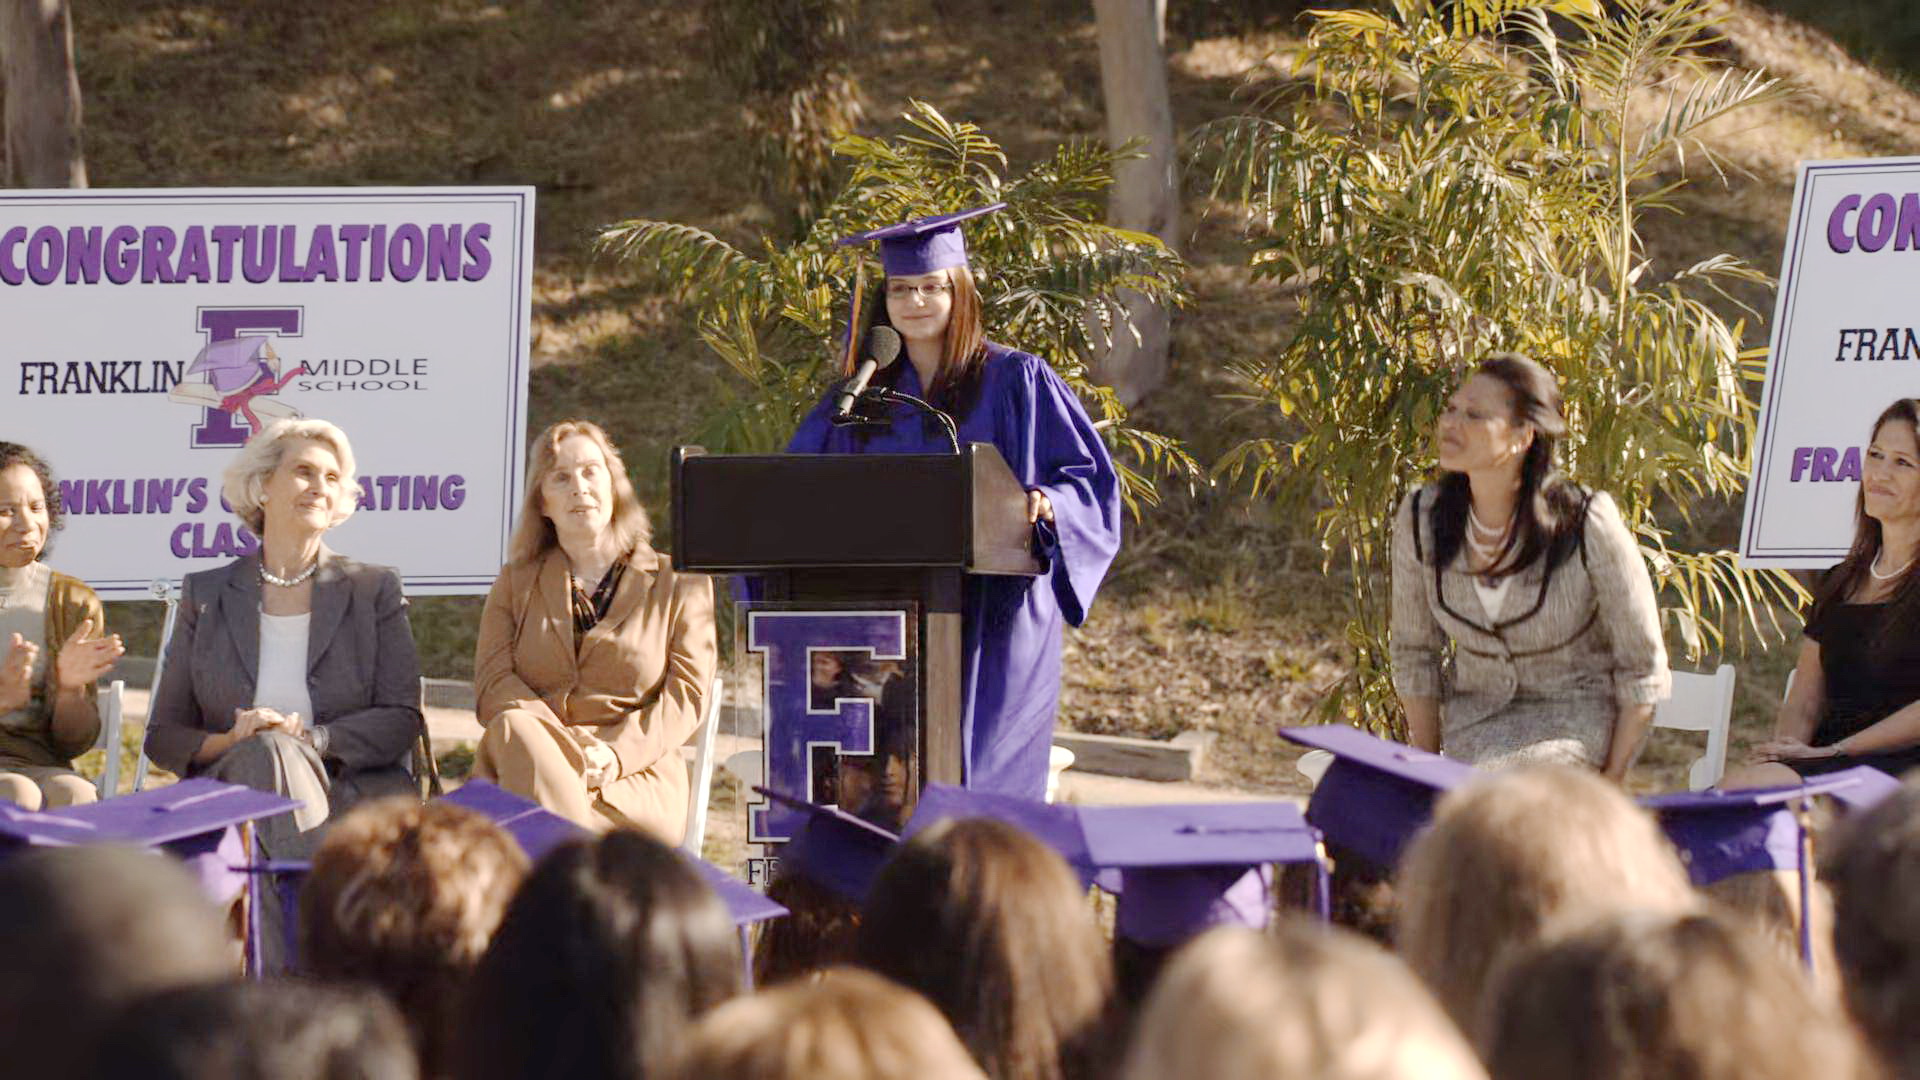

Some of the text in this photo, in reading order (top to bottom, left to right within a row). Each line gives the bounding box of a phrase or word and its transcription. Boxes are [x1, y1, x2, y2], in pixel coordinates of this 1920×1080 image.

[0, 223, 492, 286] CONGRATULATIONS
[19, 361, 184, 394] FRANKLIN
[300, 358, 428, 376] MIDDLE
[298, 380, 428, 391] SCHOOL
[170, 522, 258, 559] CLAS
